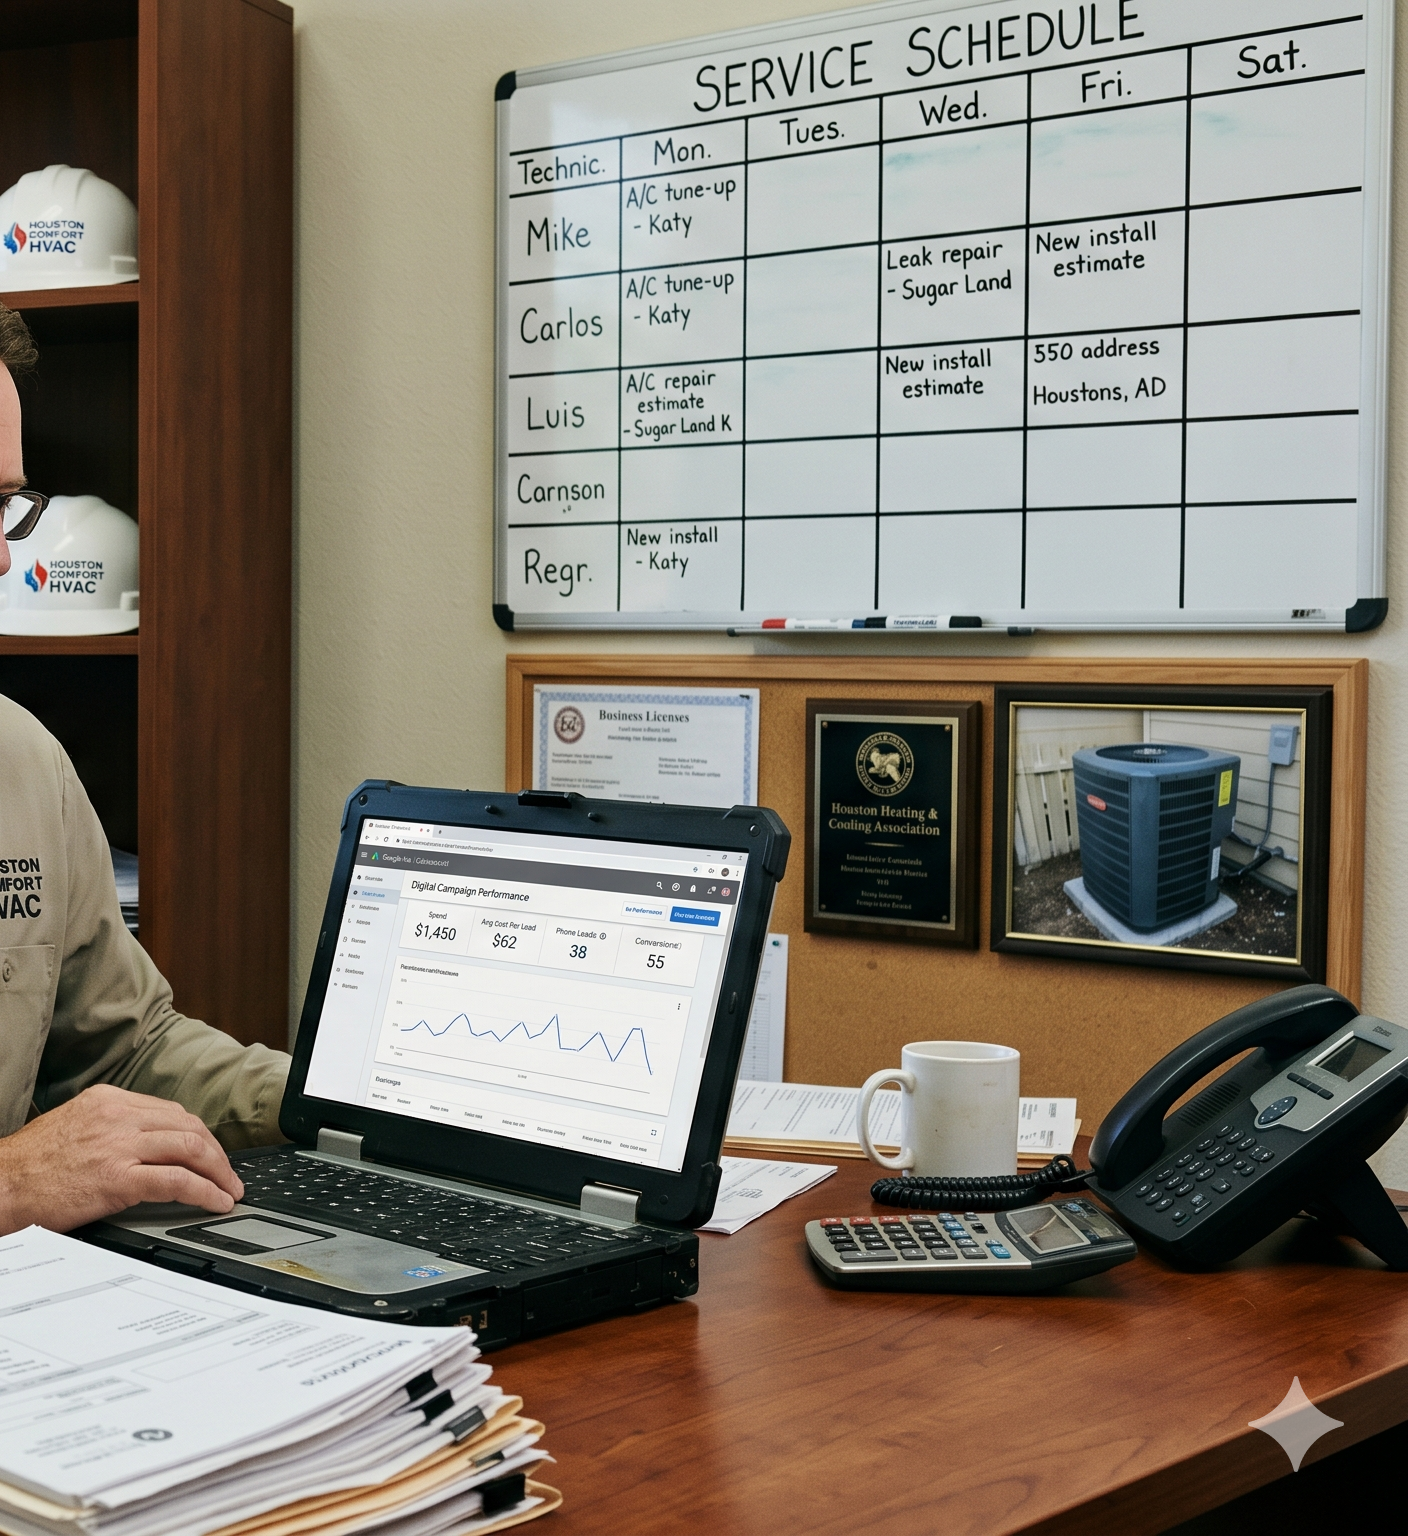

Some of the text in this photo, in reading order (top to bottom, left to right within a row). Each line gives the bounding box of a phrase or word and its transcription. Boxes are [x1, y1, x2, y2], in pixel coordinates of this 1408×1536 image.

[693, 0, 1145, 112] SERVICE SCHEDULE
[1236, 39, 1307, 79] Sat.
[1080, 70, 1132, 103] Fri.
[919, 90, 987, 126] Wed.
[779, 118, 845, 146] Tues.
[653, 138, 712, 166] Mon.
[517, 155, 606, 185] Technic.
[626, 177, 737, 209] A/C tune-up
[29, 220, 84, 229] HOUSTON
[527, 216, 592, 256] Mike
[649, 213, 692, 238] Katy
[1036, 220, 1157, 254] New install
[30, 240, 76, 253] HVAC
[887, 241, 1003, 270] Leak repair
[1053, 250, 1146, 277] estimate
[626, 271, 734, 299] A/C tune-up
[902, 278, 959, 306] Sugar
[965, 269, 1012, 294] Land
[520, 308, 603, 344] Carlos
[648, 304, 691, 330] Katy
[885, 348, 992, 375] New install
[1034, 337, 1160, 363] 550 address
[626, 370, 717, 394] A/C repair
[902, 375, 984, 399] estimate
[1033, 376, 1167, 406] Houstons, AD
[527, 396, 585, 431] Luis
[637, 393, 705, 413] estimate
[634, 419, 677, 442] Sugar
[680, 416, 717, 435] Land
[721, 414, 732, 432] K
[517, 473, 605, 504] Carnson
[626, 525, 718, 546] New install
[49, 570, 105, 580] COMFORT
[50, 560, 103, 570] HOUSTON
[524, 548, 593, 597] Regr.
[649, 552, 689, 578] Katy
[50, 581, 97, 594] HVAC
[646, 711, 690, 723] Licenses
[881, 805, 925, 822] Heating
[928, 807, 938, 820] &
[874, 821, 940, 836] Association
[411, 880, 530, 902] Digital Campaign Performance
[428, 911, 447, 920] Spend
[494, 920, 509, 928] Cost
[521, 923, 537, 931] Lead
[414, 922, 457, 941] $1,450
[492, 932, 517, 949] $62
[556, 927, 576, 937] Phone
[569, 944, 588, 959] 38
[646, 954, 666, 969] 55
